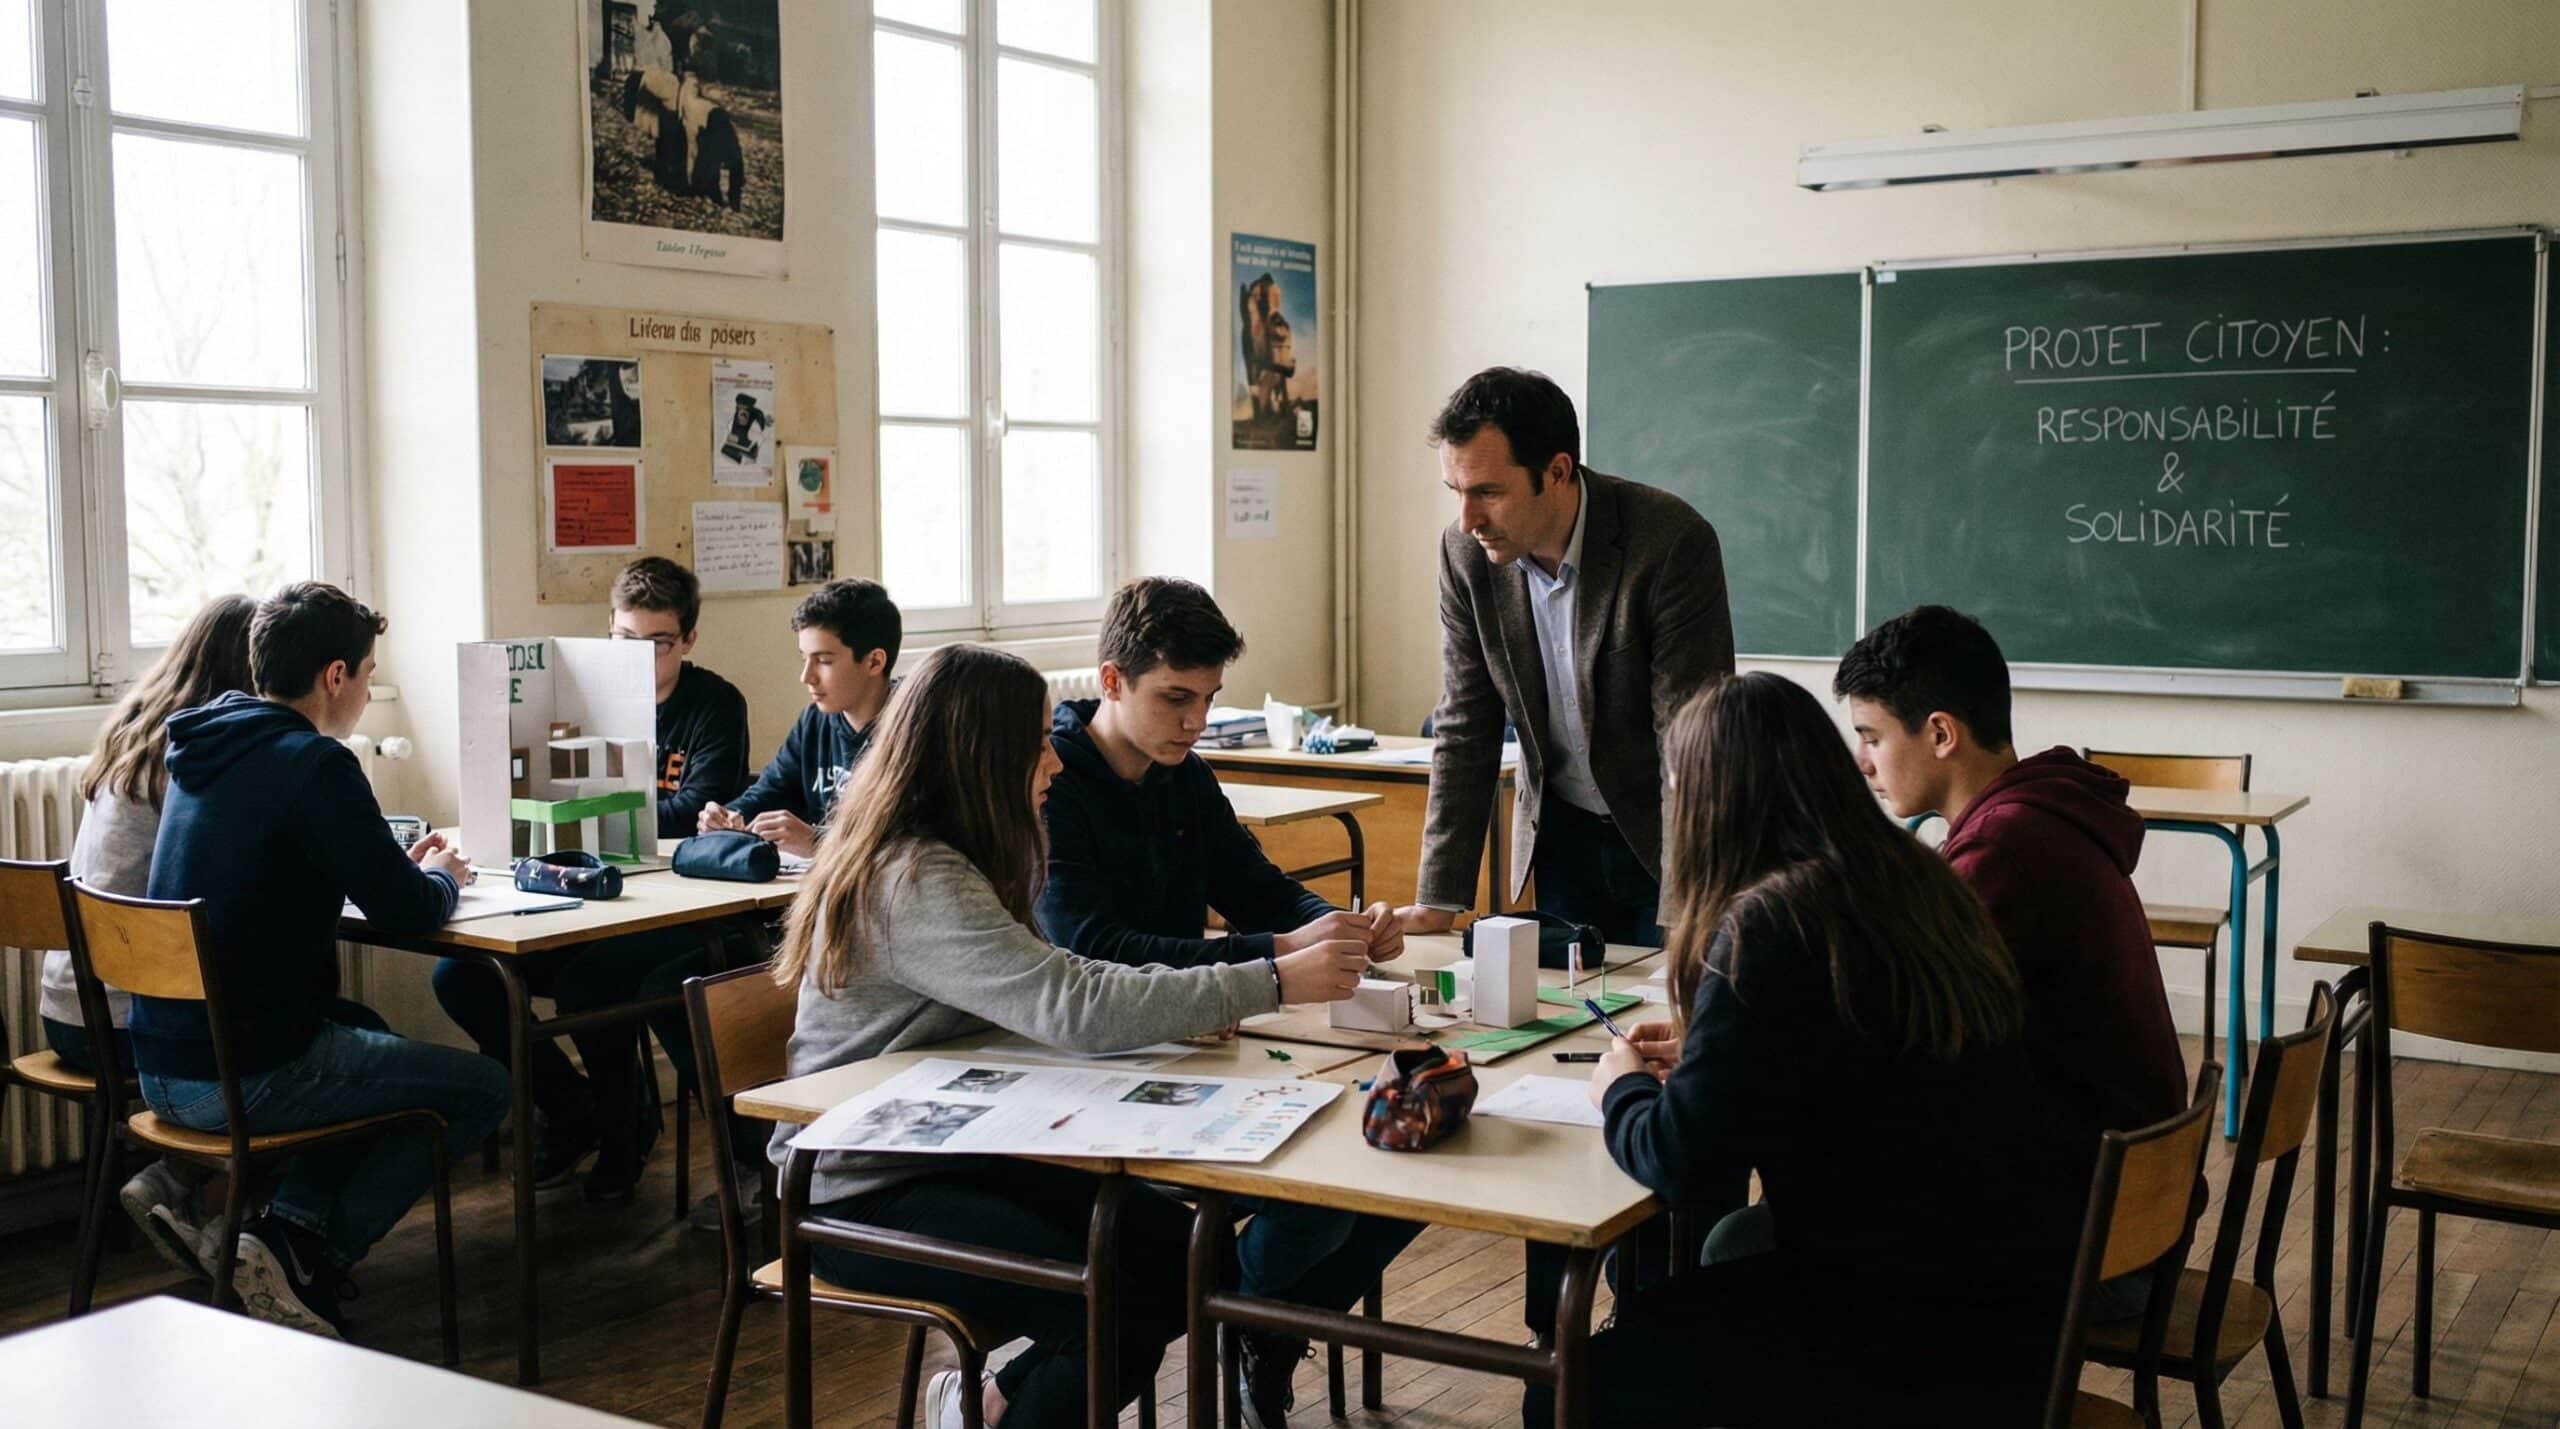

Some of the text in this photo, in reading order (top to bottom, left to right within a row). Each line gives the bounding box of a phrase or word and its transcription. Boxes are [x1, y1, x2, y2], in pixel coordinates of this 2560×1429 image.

[2004, 322, 2163, 371] PROJET
[2037, 389, 2337, 444] RESPONSABILITÉ
[2157, 451, 2185, 493] &
